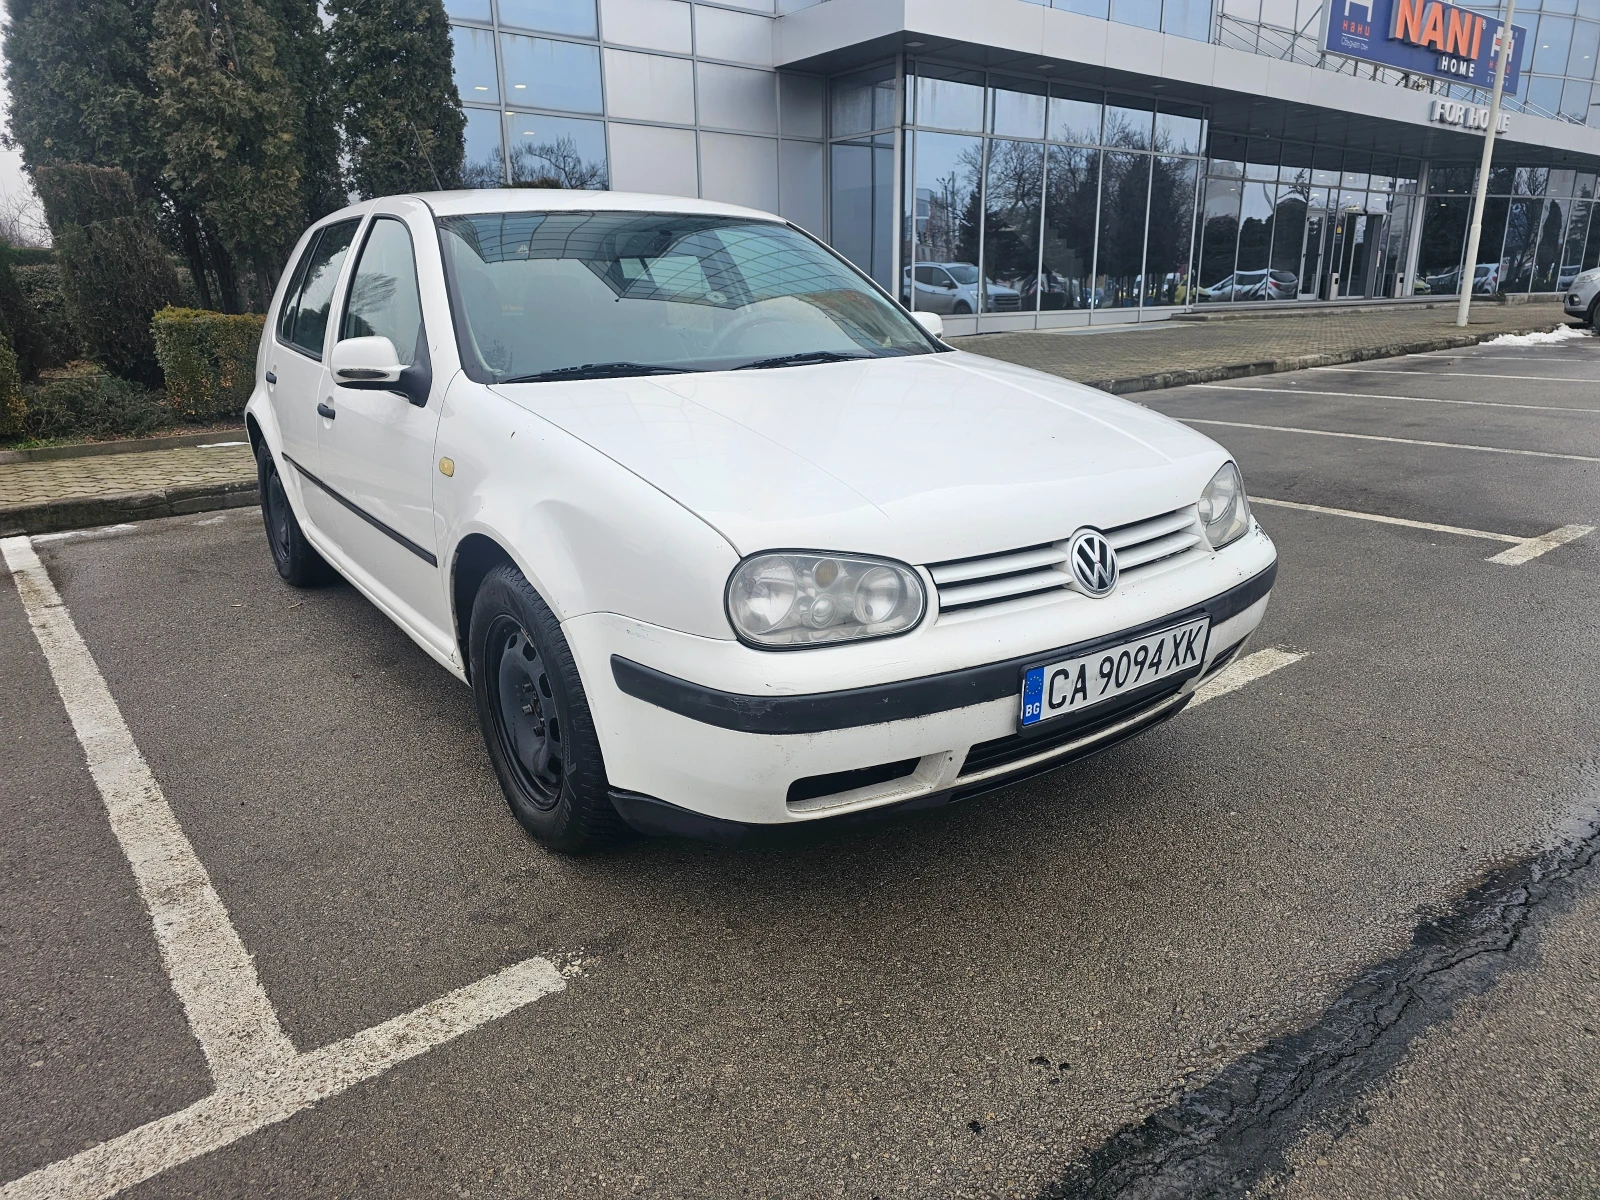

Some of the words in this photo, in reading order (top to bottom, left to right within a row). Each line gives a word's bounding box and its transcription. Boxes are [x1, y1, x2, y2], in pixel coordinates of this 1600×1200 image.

[1393, 0, 1484, 60] NANI
[1441, 56, 1475, 77] HOME
[1432, 100, 1465, 124] FOR
[1048, 663, 1088, 709] CA
[1099, 638, 1165, 695] 9094
[1166, 625, 1203, 670] XK
[1025, 703, 1040, 717] BG
